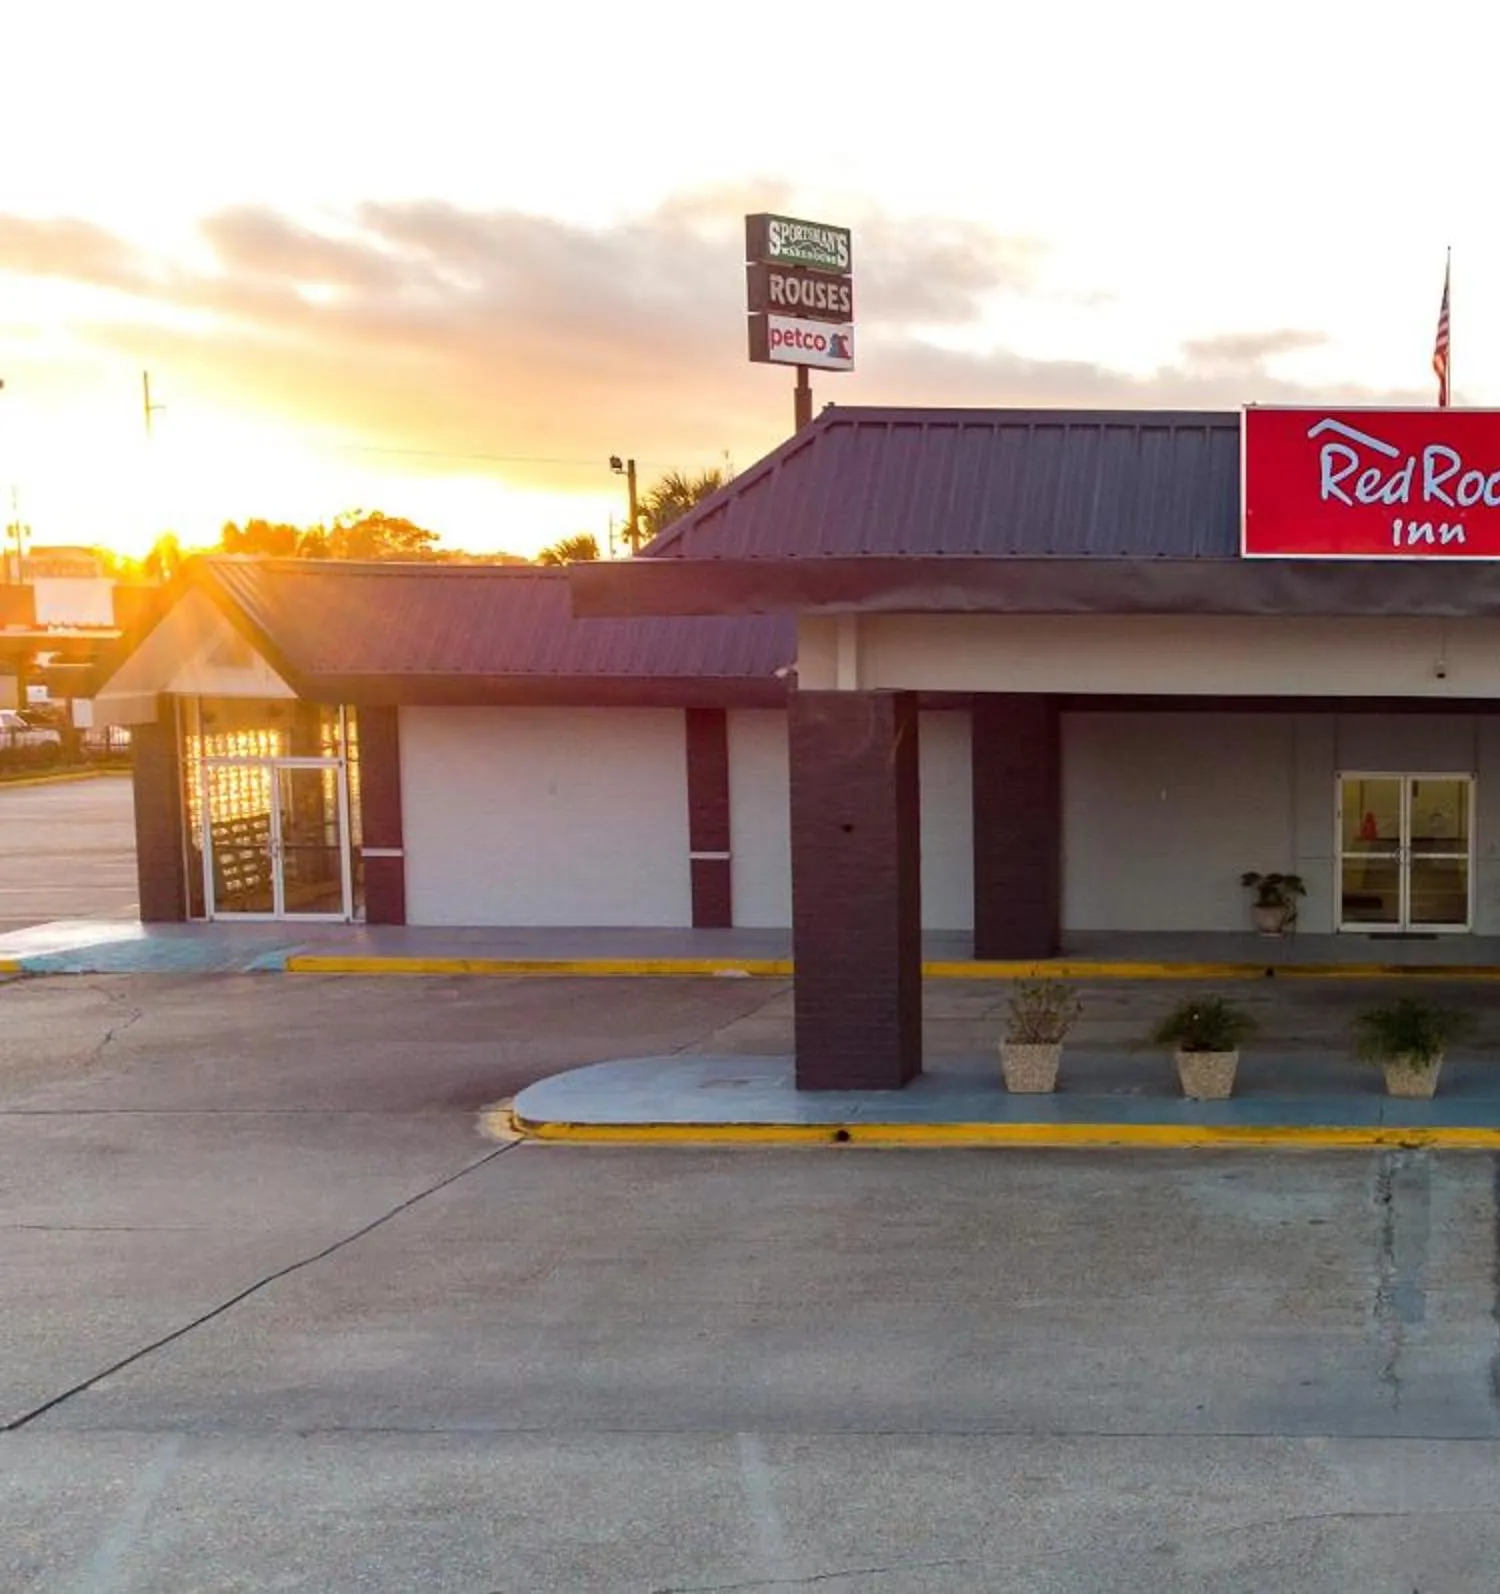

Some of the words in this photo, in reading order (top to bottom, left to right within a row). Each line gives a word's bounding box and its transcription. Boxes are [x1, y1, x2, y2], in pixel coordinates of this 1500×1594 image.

[769, 274, 850, 312] ROUSES
[771, 328, 827, 350] petco
[1319, 442, 1417, 507] Red
